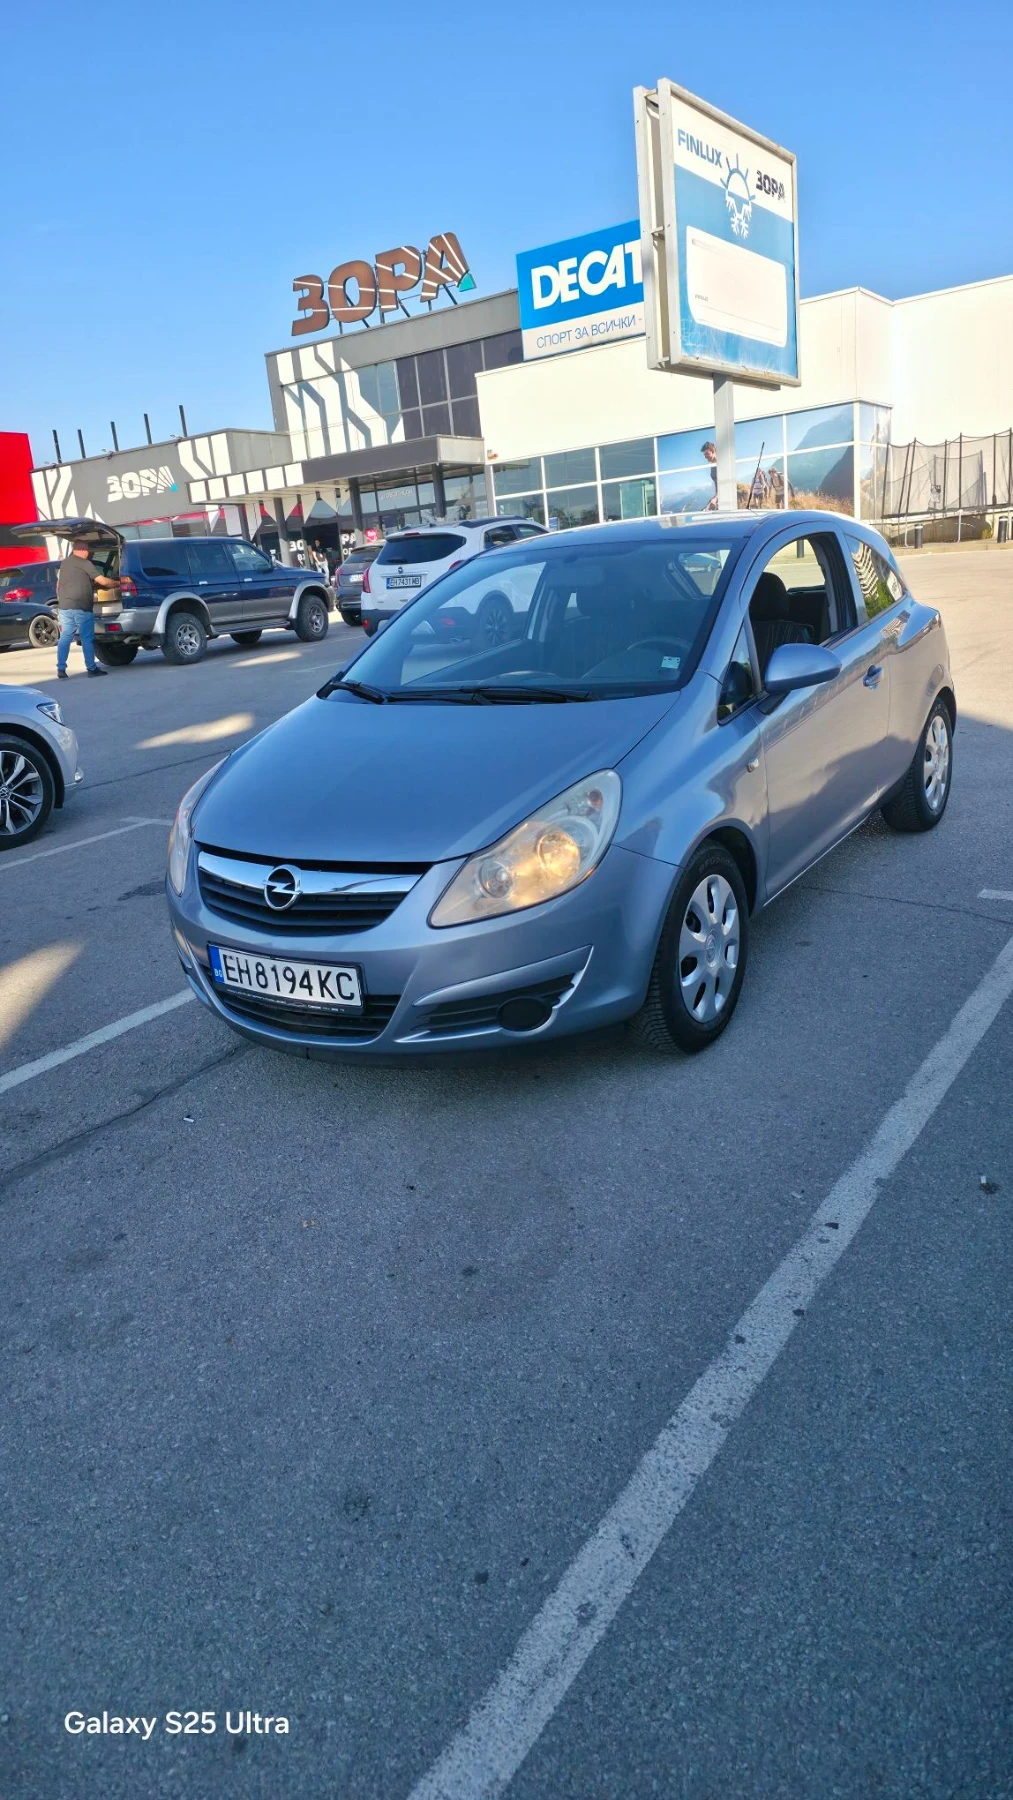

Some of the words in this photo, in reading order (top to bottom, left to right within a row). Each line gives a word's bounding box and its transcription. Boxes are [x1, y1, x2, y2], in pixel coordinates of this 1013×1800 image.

[677, 128, 722, 168] FINLUX
[291, 232, 477, 337] ЗОРА
[536, 329, 572, 348] СПОРТ
[575, 326, 589, 340] ЗА
[591, 314, 636, 336] ВСИЧКИ
[106, 465, 178, 503] ЗОРА
[222, 953, 356, 1001] EH8194KC
